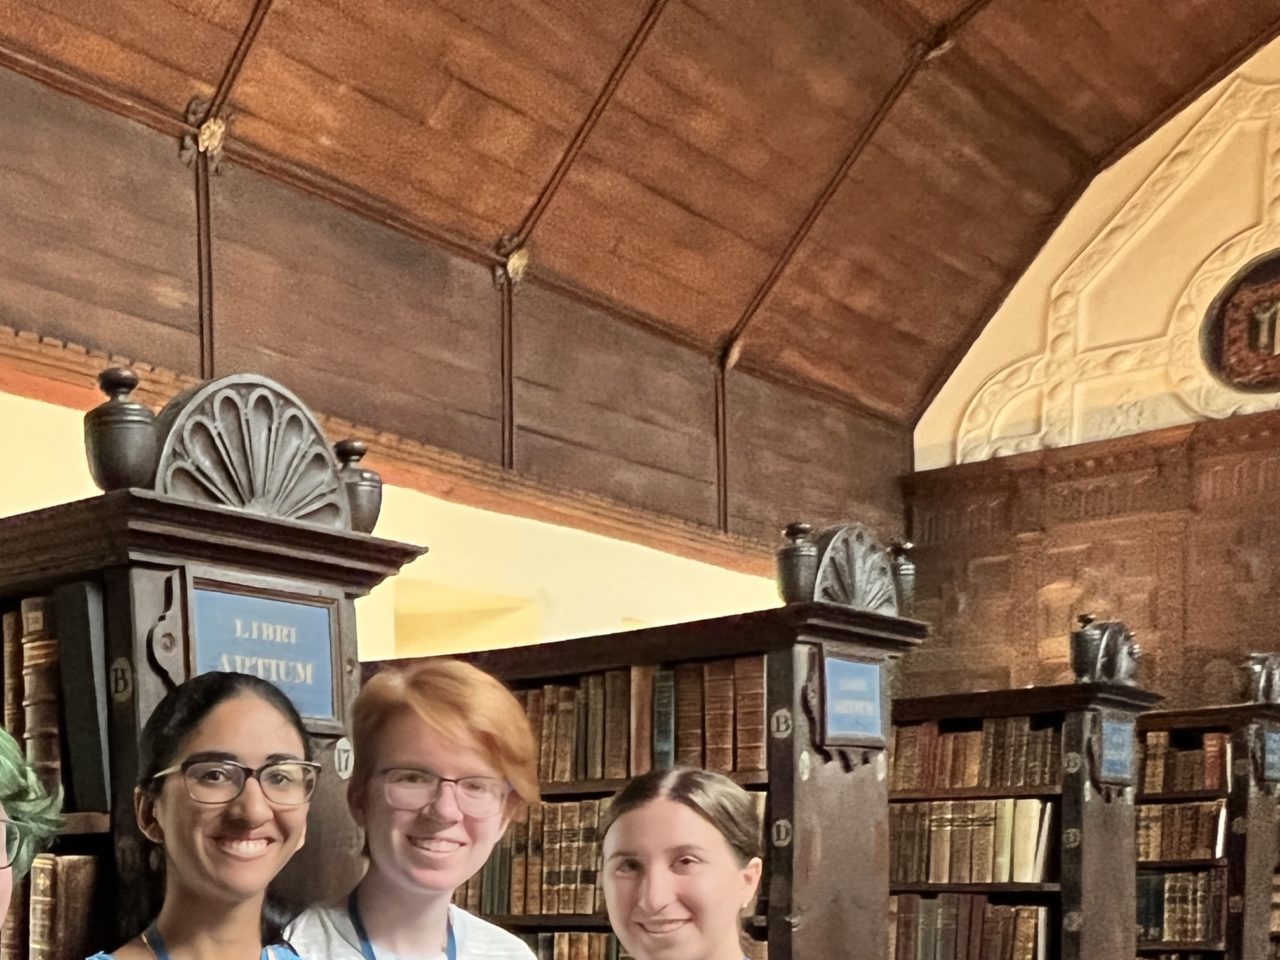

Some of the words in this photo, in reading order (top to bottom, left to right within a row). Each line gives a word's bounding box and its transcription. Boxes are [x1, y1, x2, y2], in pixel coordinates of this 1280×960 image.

[234, 619, 297, 645] LIBRI
[112, 668, 129, 694] B
[775, 714, 791, 733] B
